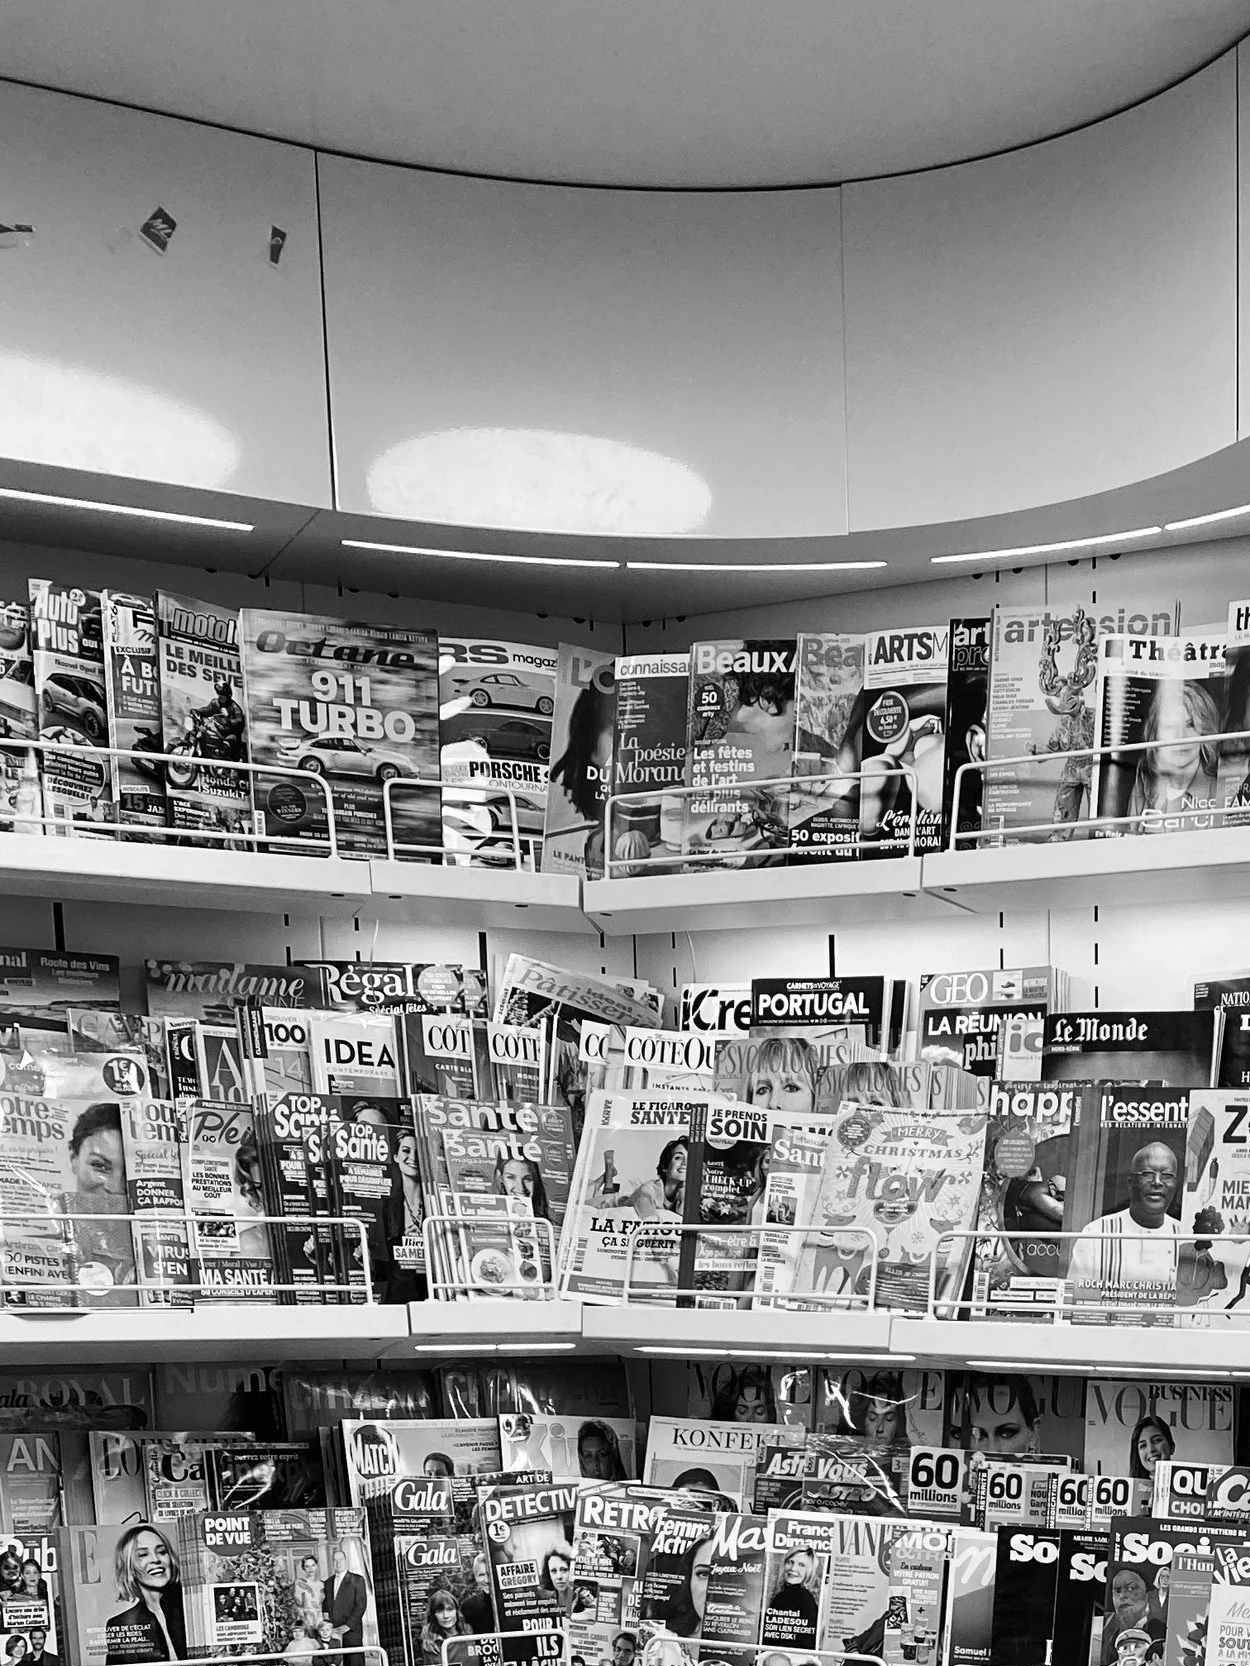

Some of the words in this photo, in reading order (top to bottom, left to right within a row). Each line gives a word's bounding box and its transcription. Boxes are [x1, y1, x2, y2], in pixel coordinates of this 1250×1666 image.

[35, 591, 78, 625] Auto
[37, 621, 79, 654] Plus
[255, 629, 415, 668] Octane
[310, 671, 371, 705] 911
[273, 697, 416, 742] TURBO
[694, 748, 714, 761] Les
[718, 746, 752, 760] fêtes
[469, 760, 541, 784] PORSCHE
[692, 762, 706, 773] et
[709, 760, 754, 773] festins
[40, 956, 67, 969] Route
[70, 958, 85, 969] des
[88, 959, 109, 972] Vins
[321, 963, 415, 1004] Régal
[930, 974, 987, 1005] GEO
[369, 1004, 399, 1016] Spécial
[402, 1002, 427, 1014] fêtes
[758, 994, 870, 1015] PORTUGAL
[264, 1023, 306, 1044] 100
[1051, 1019, 1077, 1043] Le
[1076, 1017, 1149, 1042] Monde
[712, 1108, 723, 1120] JE
[726, 1109, 768, 1122] PRENDS
[349, 1122, 372, 1138] TOP
[710, 1118, 767, 1141] SOIN
[897, 1126, 941, 1140] MERRY
[335, 1134, 389, 1163] Santé
[448, 1134, 543, 1162] santé
[862, 1145, 963, 1158] CHRISTMAS
[672, 1427, 786, 1451] KONFEKT
[351, 1434, 399, 1477] MATCH
[911, 1452, 960, 1490] 60
[394, 1480, 454, 1516] Gala
[909, 1490, 959, 1504] millions
[205, 1516, 252, 1534] POINT
[207, 1530, 224, 1546] DE
[226, 1529, 252, 1546] VUE
[499, 1562, 536, 1577] AFFAIRE
[501, 1573, 538, 1587] GREGORY
[766, 1616, 808, 1626] LADESOU
[767, 1608, 800, 1617] Chantal
